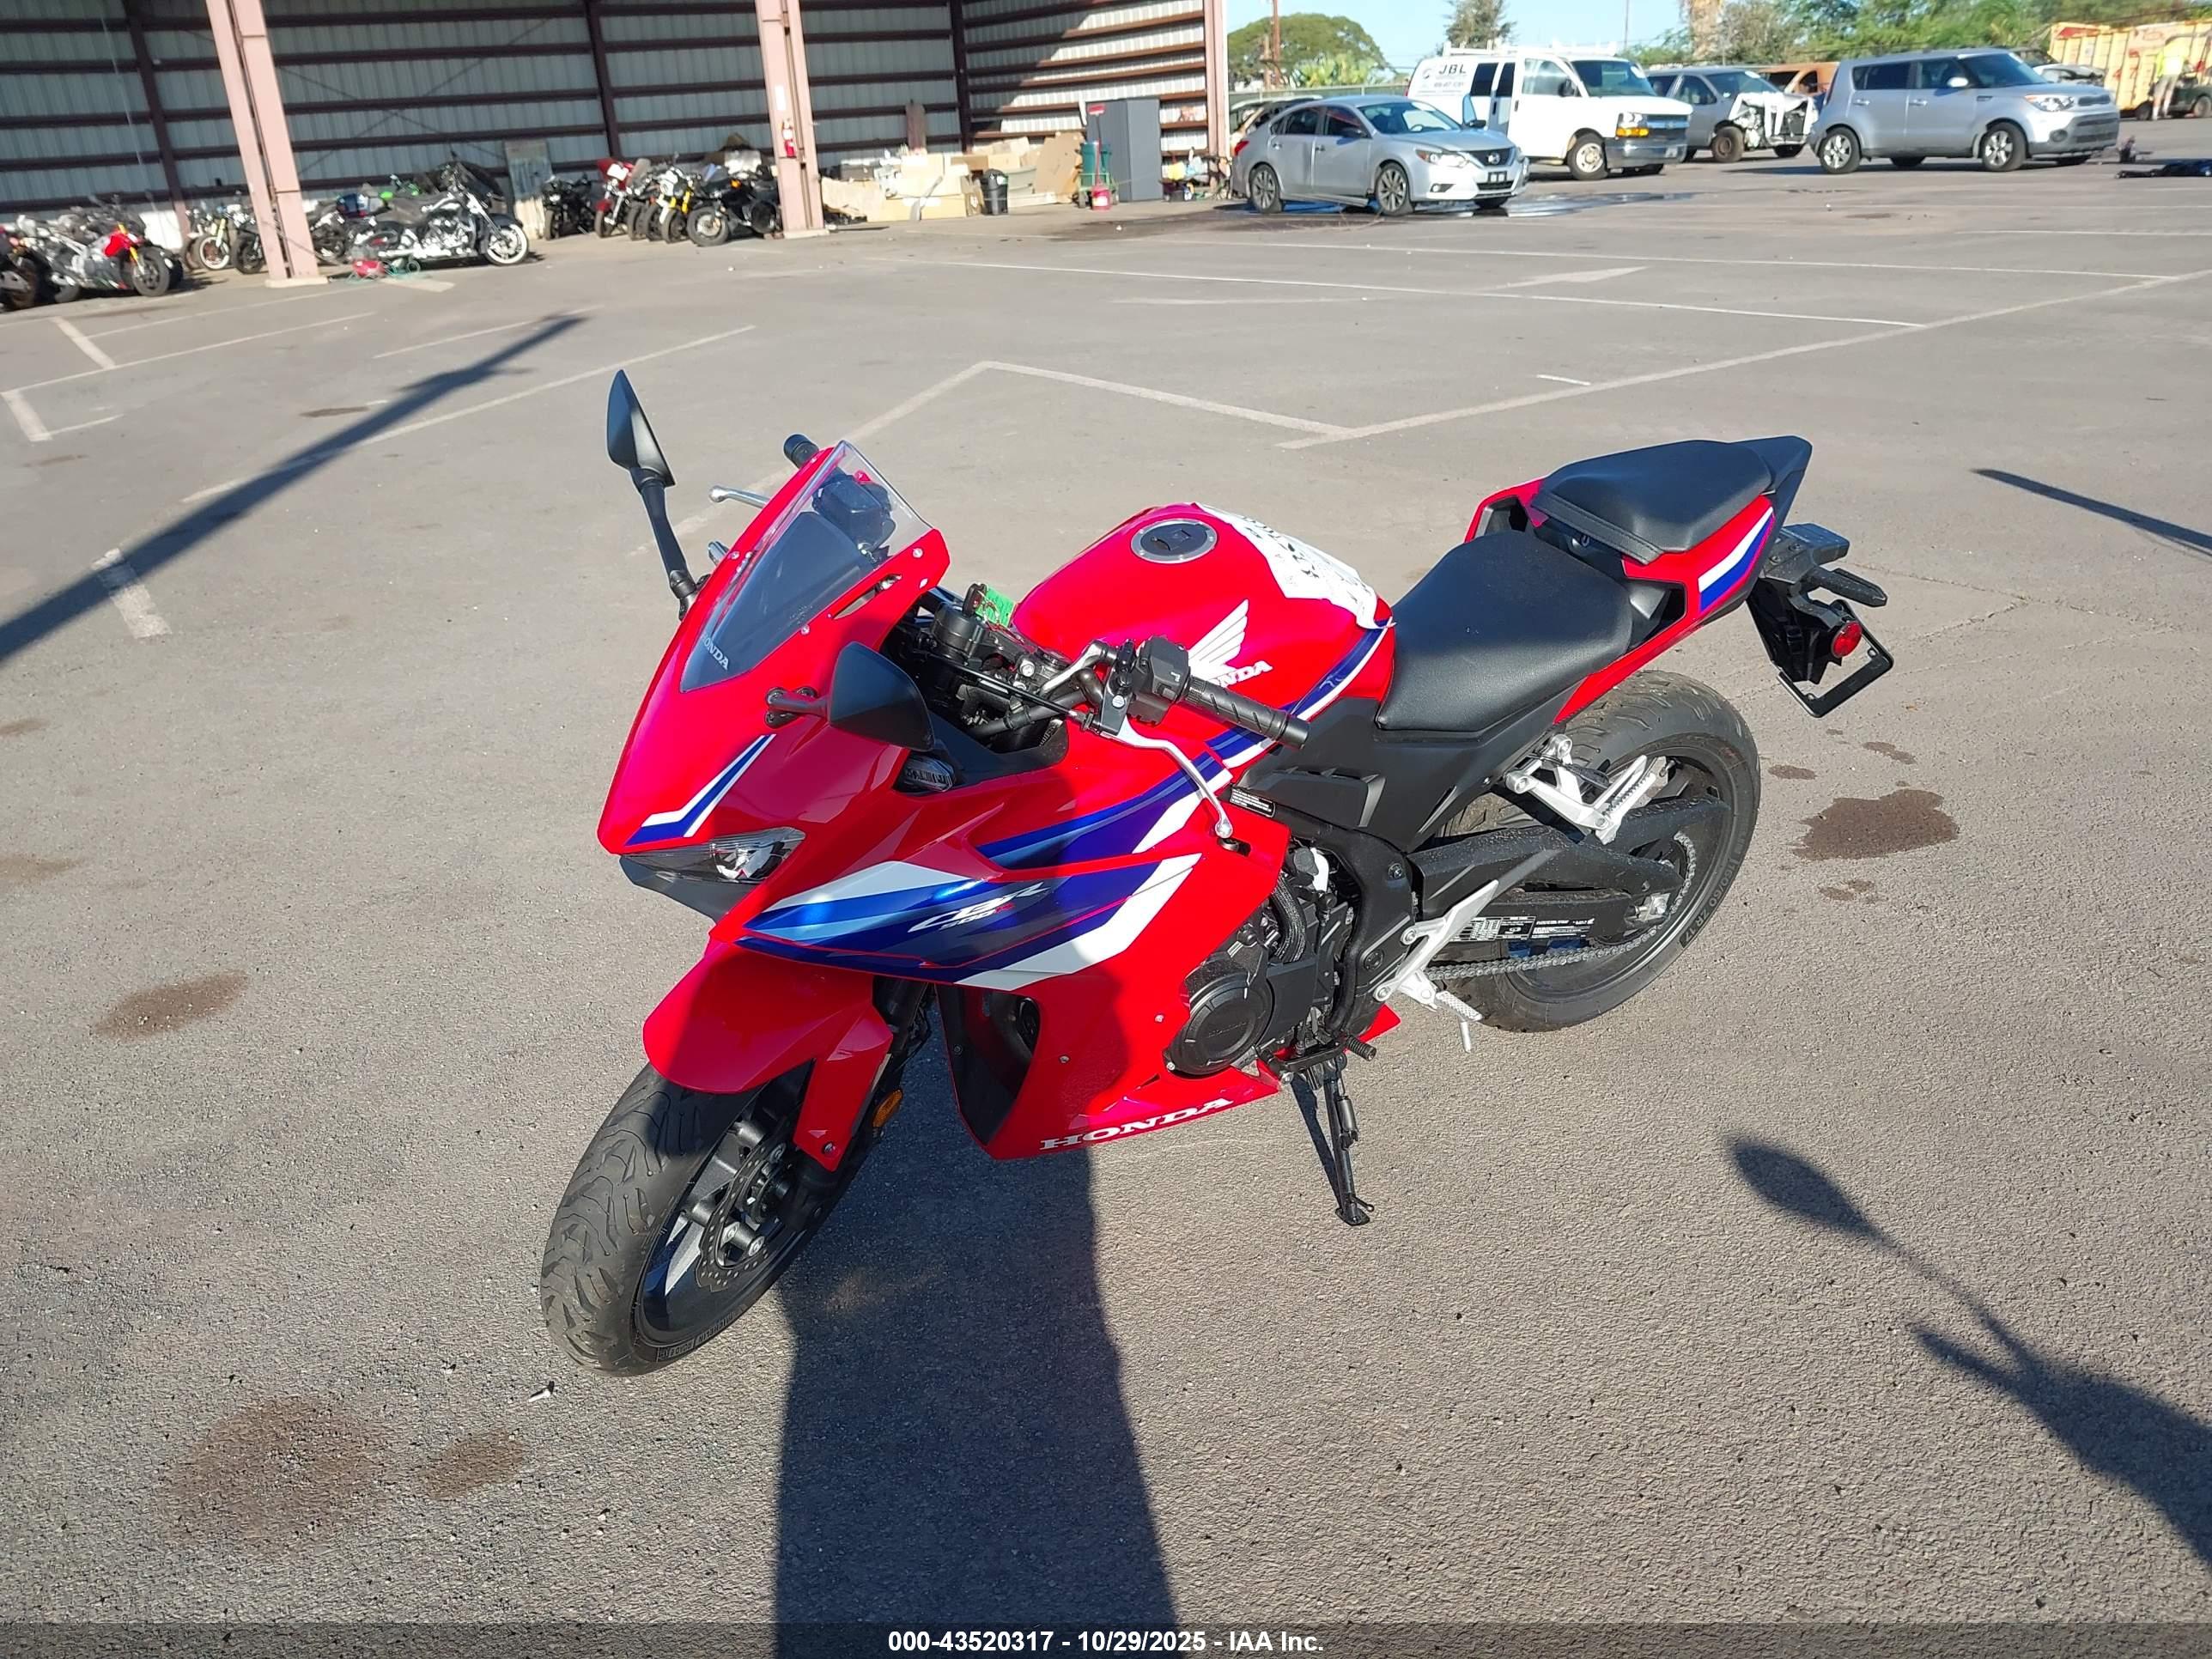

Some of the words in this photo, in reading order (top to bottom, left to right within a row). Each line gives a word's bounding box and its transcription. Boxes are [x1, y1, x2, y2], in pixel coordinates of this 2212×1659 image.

[1438, 64, 1467, 75] JBL
[1710, 861, 1736, 908] 160/60
[908, 882, 1051, 933] CBR
[1695, 908, 1710, 927] ZR
[1685, 927, 1697, 942] 17
[1040, 1097, 1234, 1151] HONDA
